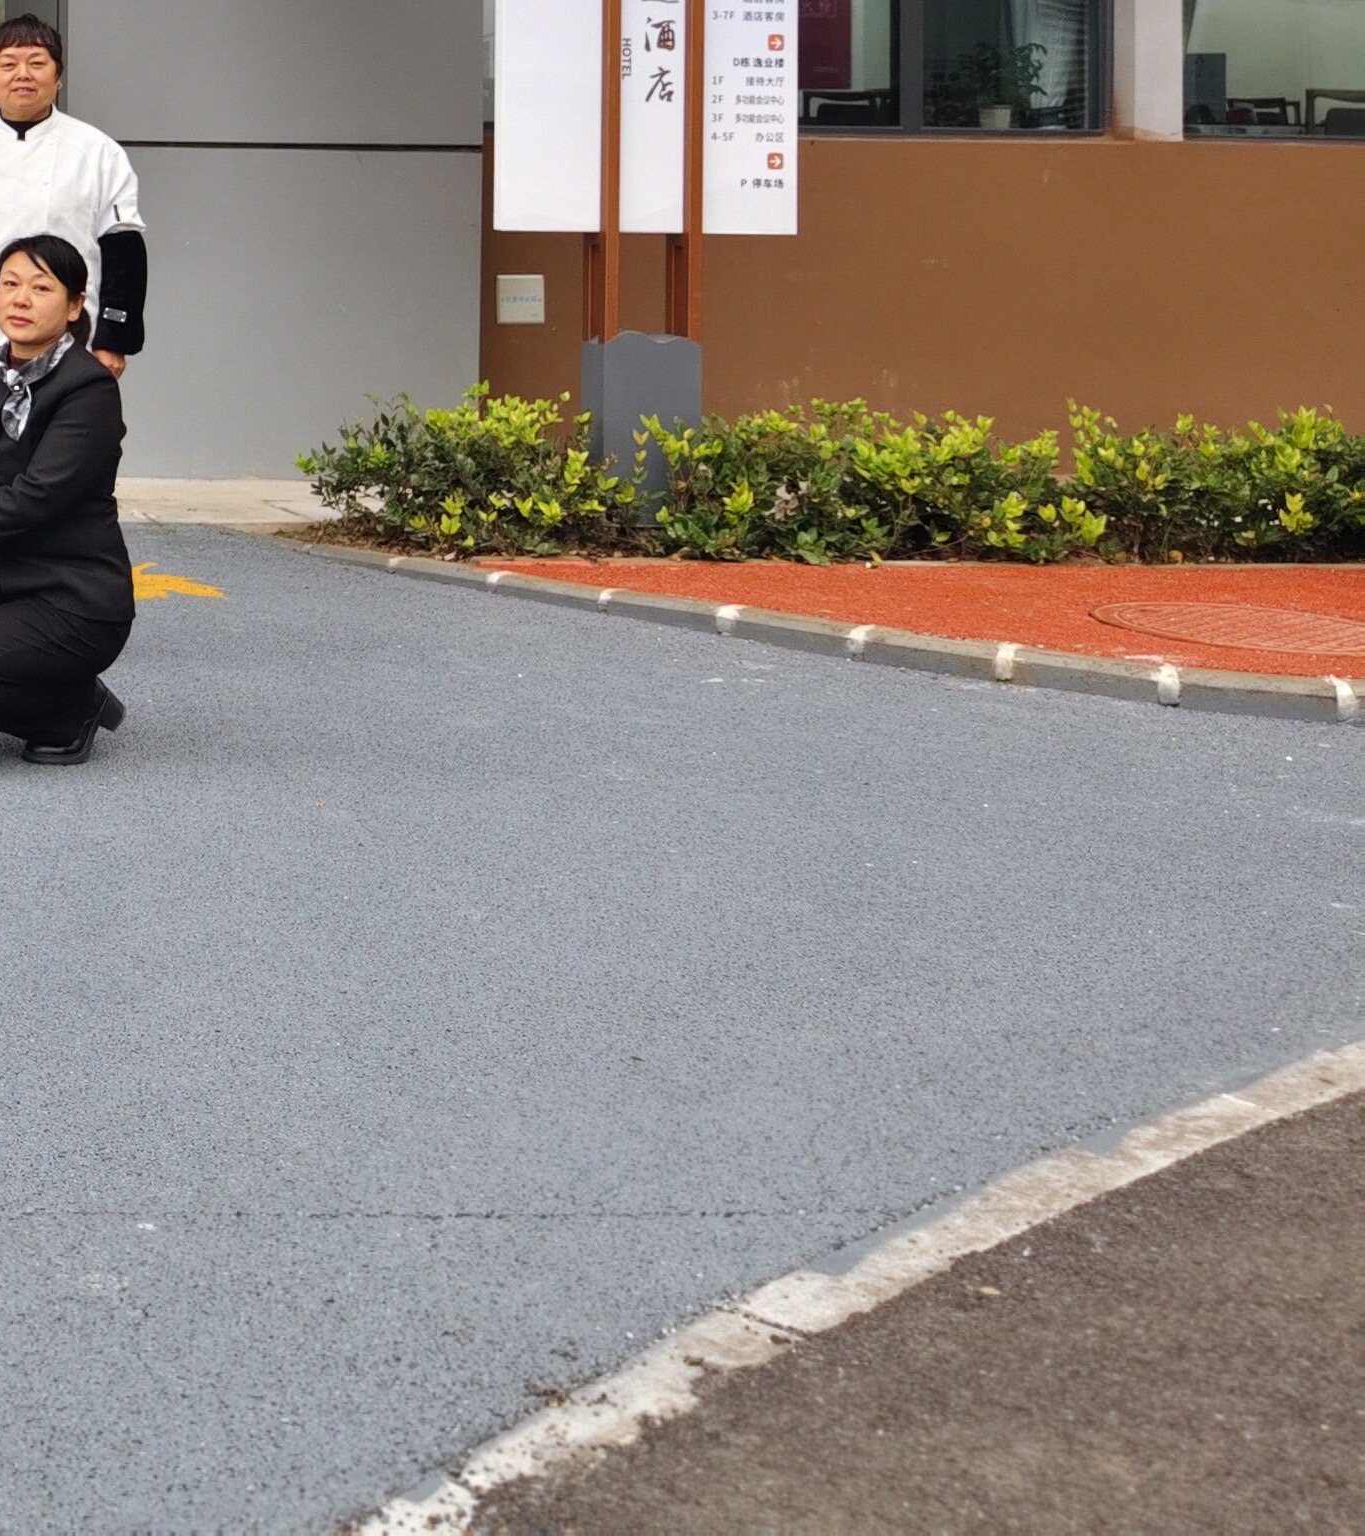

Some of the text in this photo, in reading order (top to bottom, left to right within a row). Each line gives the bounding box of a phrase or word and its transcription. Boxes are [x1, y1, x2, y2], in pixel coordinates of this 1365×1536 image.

[712, 10, 785, 22] 3-7F 酒店客房
[622, 37, 632, 80] HOTEL
[733, 57, 750, 68] D栋
[712, 75, 785, 87] 1F 接待大厅
[711, 94, 724, 104] 2F
[711, 113, 724, 123] 3F
[711, 131, 785, 143] 4-5F 办公区
[752, 178, 784, 189] 停车场
